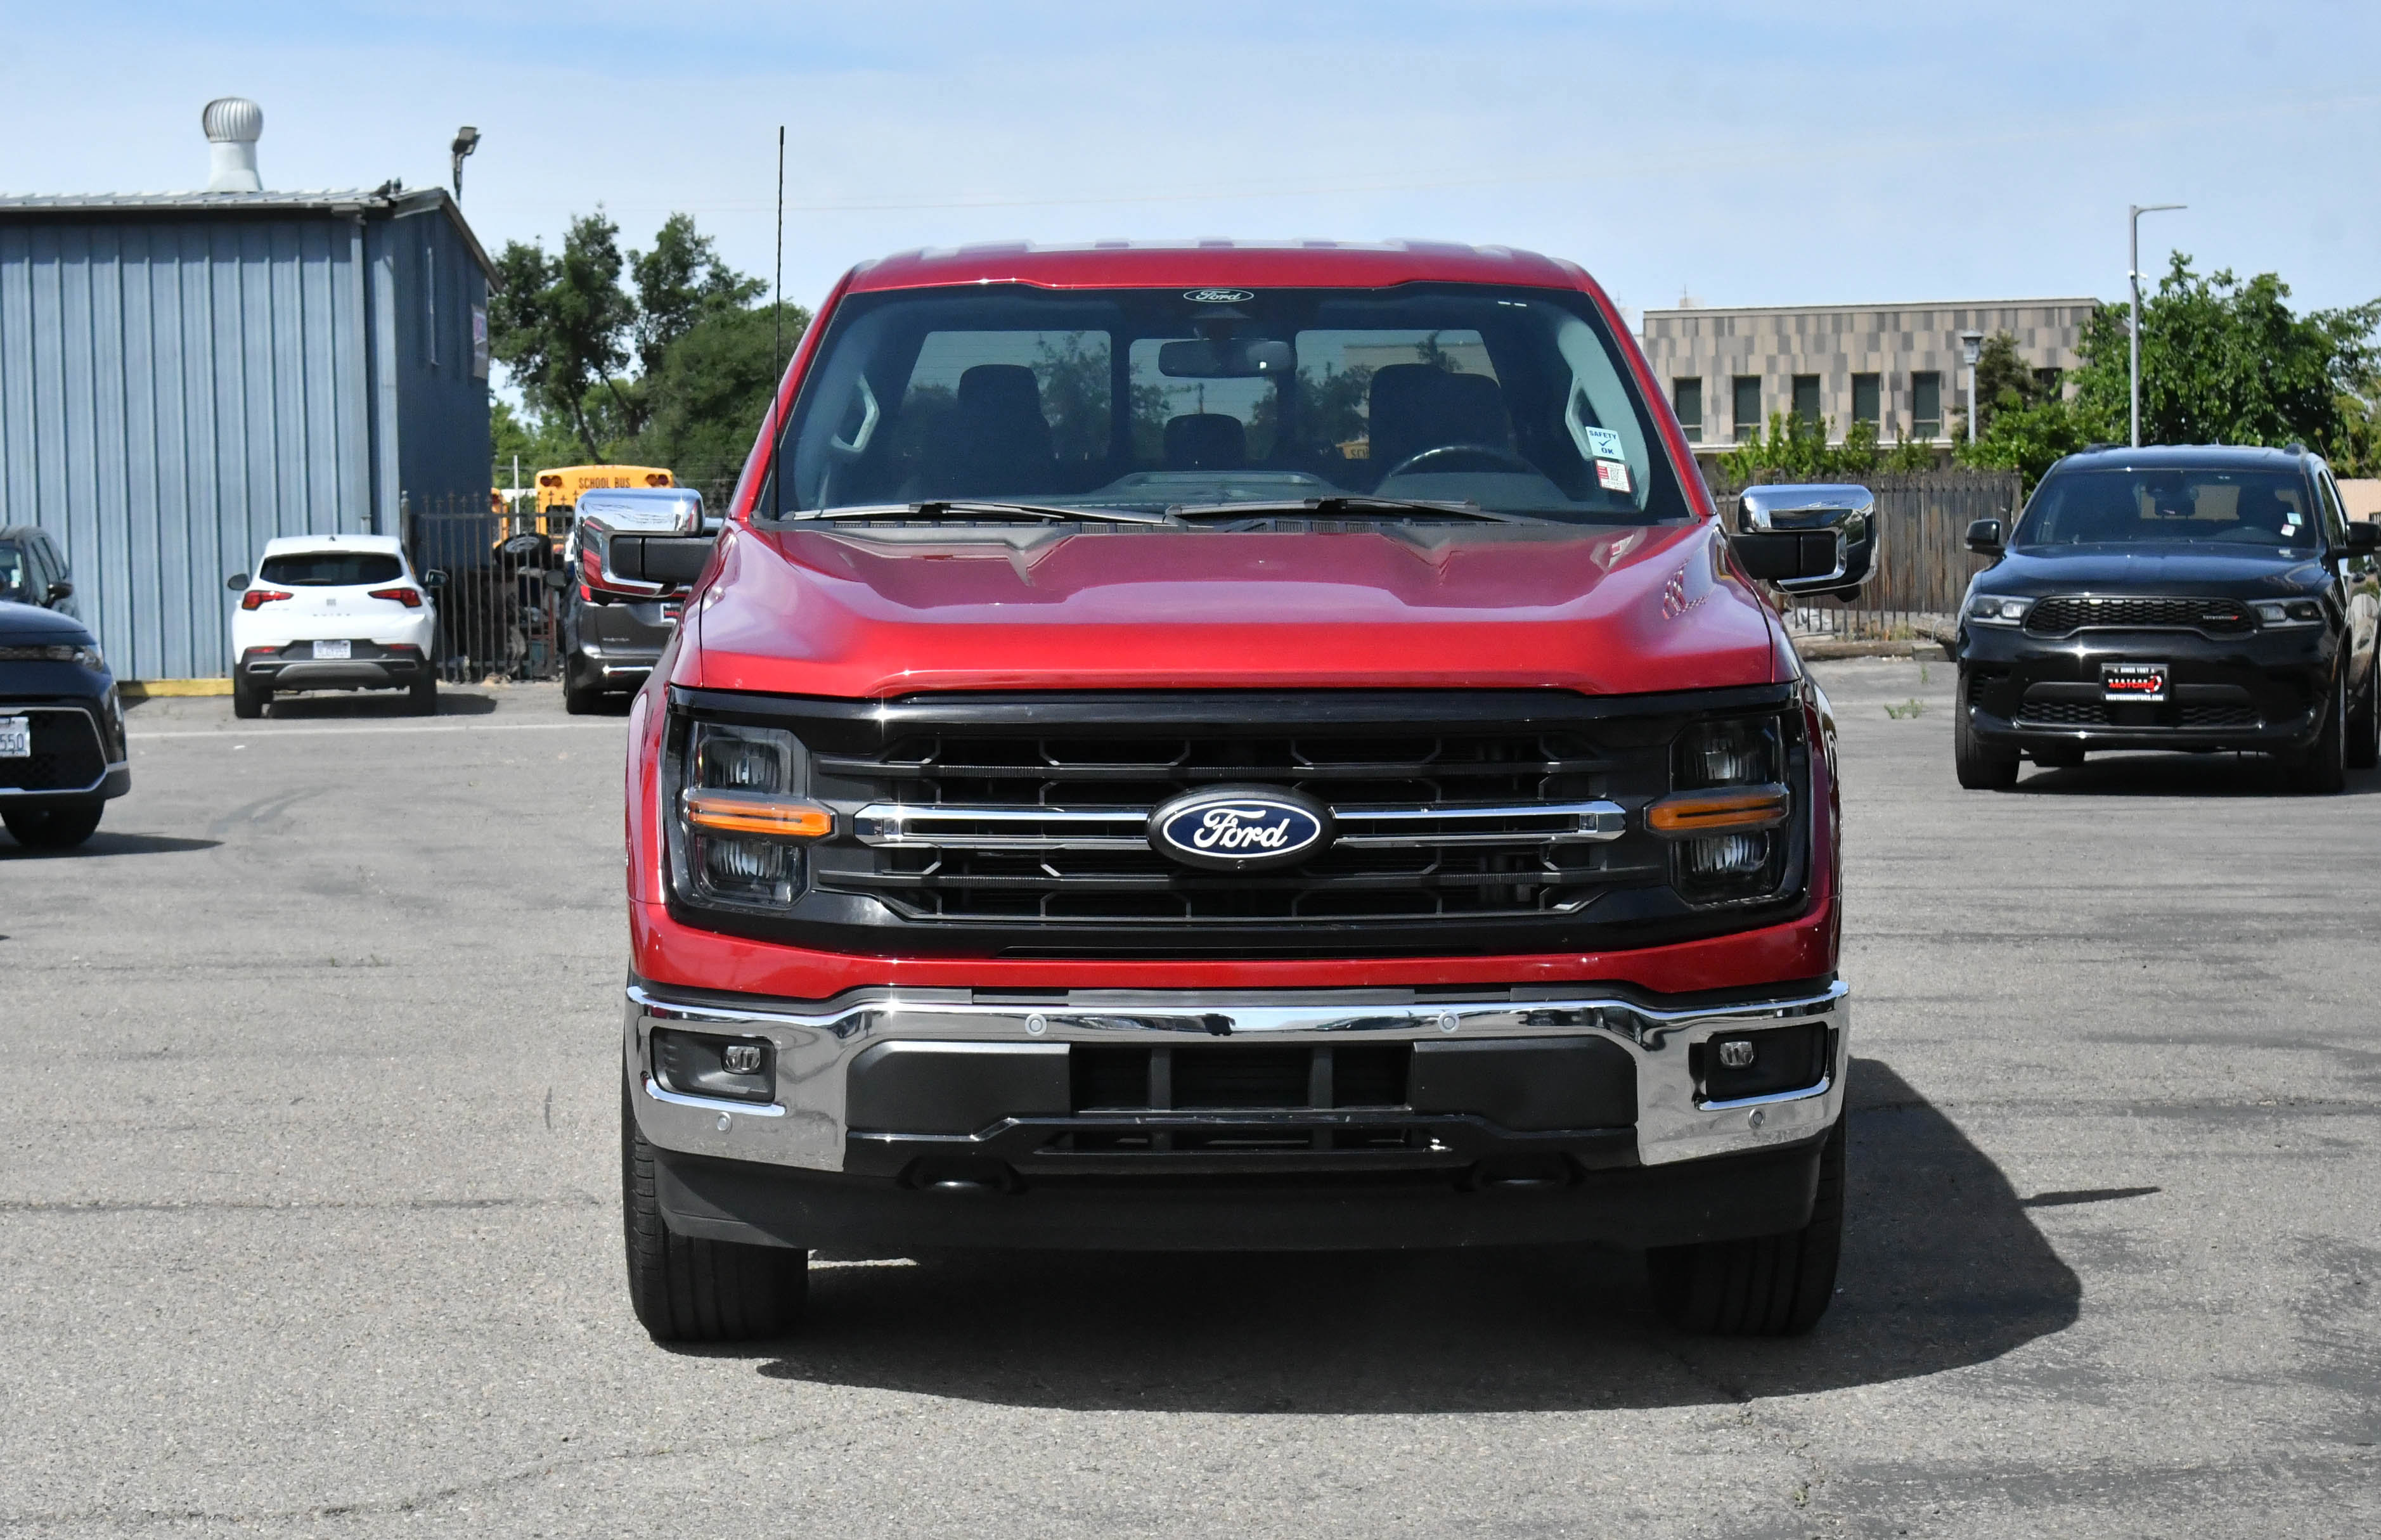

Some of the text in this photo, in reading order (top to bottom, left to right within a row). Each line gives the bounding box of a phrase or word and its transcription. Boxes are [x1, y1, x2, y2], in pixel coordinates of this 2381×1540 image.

[1196, 291, 1242, 300] Ford
[1589, 430, 1616, 440] SAFETY
[579, 477, 631, 489] SCHOOL BUS
[1194, 808, 1291, 848] Ford
